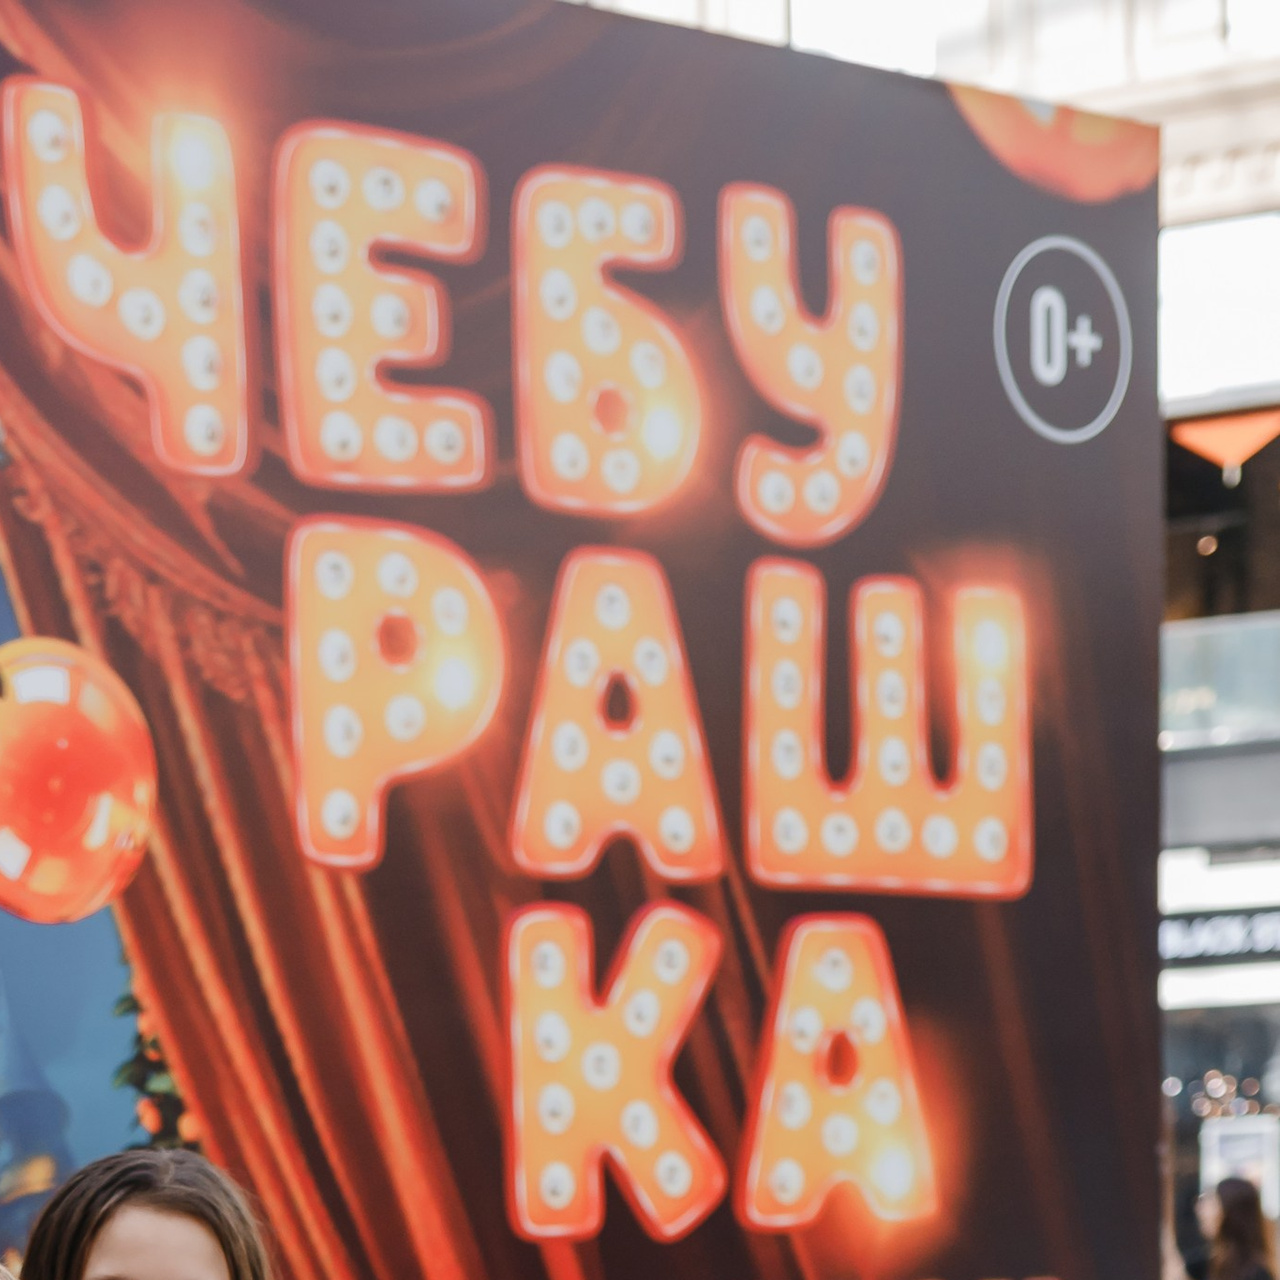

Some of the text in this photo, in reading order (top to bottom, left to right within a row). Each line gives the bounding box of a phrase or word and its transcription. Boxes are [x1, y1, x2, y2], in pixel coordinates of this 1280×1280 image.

[0, 72, 904, 549] ЧЕБУ
[1028, 284, 1104, 387] 0+
[283, 513, 1036, 899] РАШ
[506, 899, 939, 1244] КА
